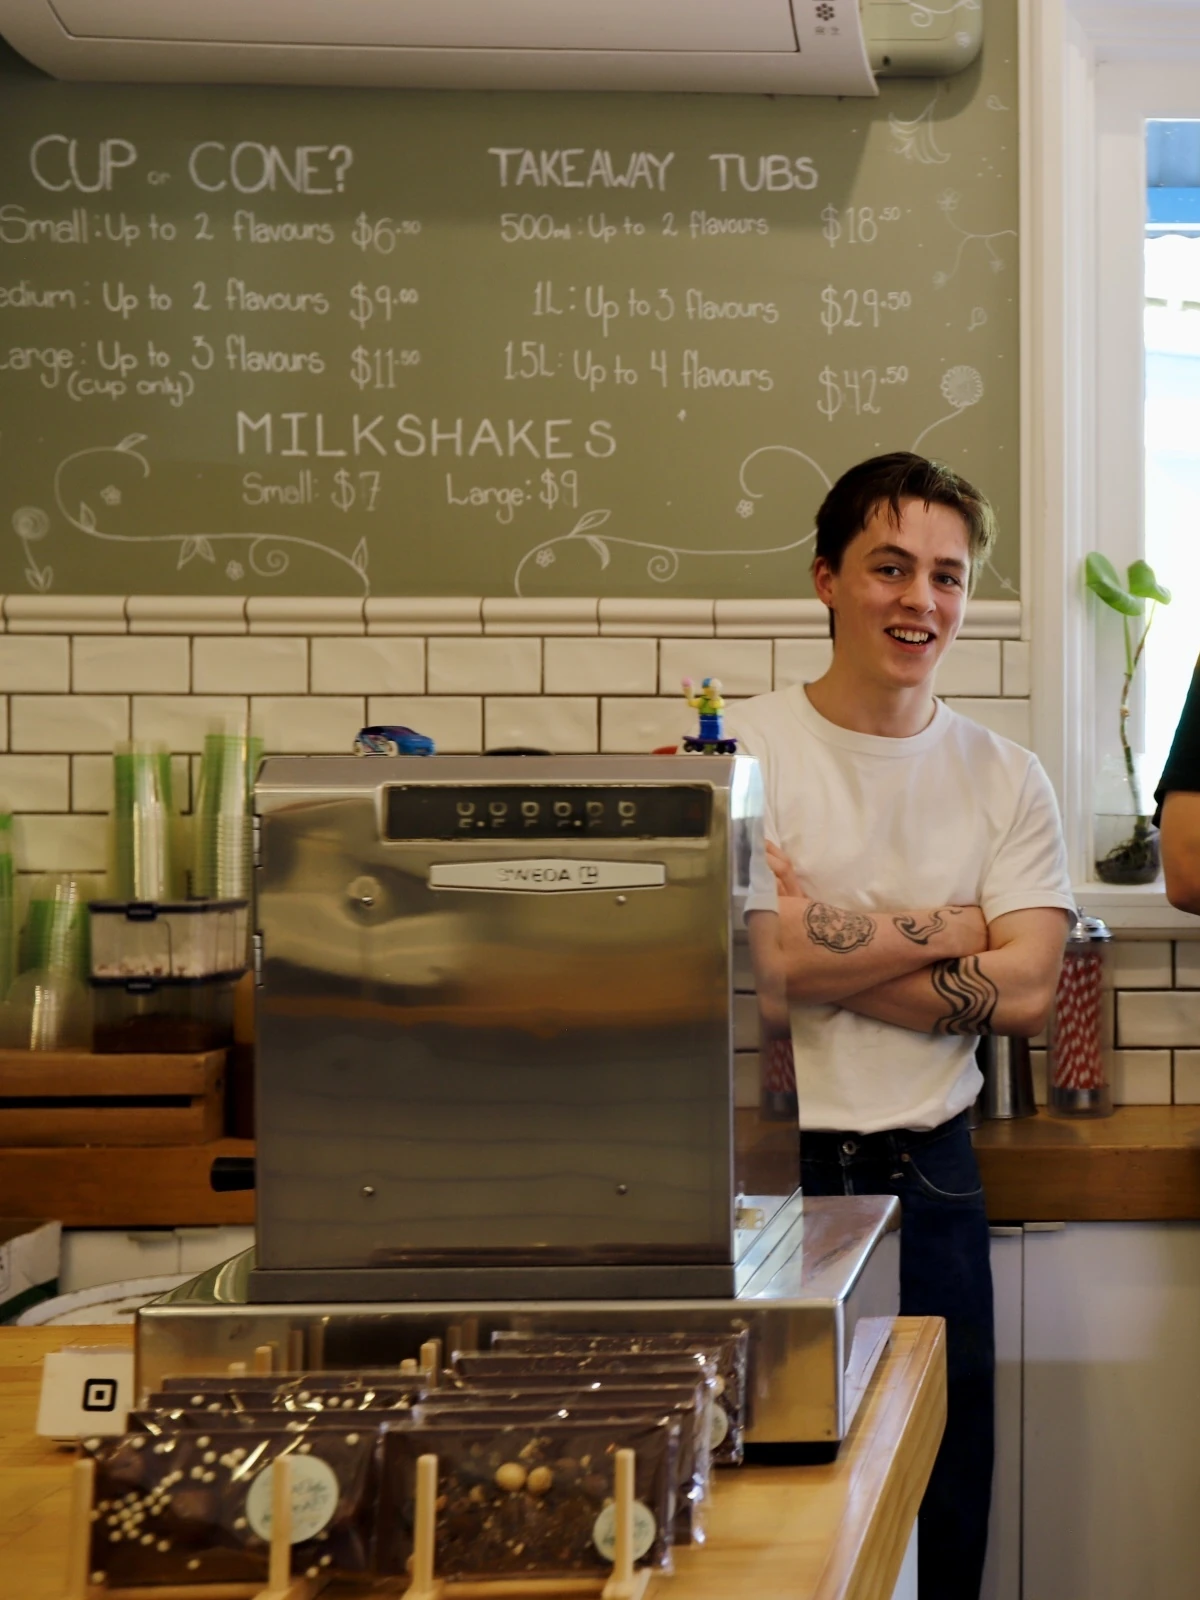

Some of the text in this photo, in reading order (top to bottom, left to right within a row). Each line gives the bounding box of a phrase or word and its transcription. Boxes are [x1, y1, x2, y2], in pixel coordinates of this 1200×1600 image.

[30, 135, 354, 194] CUP or CONE?
[487, 147, 819, 192] TAKEAWAY TUBS
[0, 204, 421, 254] Small: Up to 2 flavours $6.50
[587, 212, 617, 244] Up
[622, 215, 646, 237] to
[662, 211, 679, 237] 2
[689, 210, 770, 239] flavours
[821, 203, 901, 248] $18.50
[0, 277, 419, 330] edium: Up to 2 flavours $9.00
[585, 284, 619, 338] Up
[628, 287, 650, 317] to
[655, 288, 675, 321] 3
[686, 288, 779, 324] flavours
[821, 284, 912, 335] $29.50
[97, 340, 139, 378] Up
[148, 340, 171, 368] to
[192, 335, 215, 371] 3
[225, 333, 326, 374] flavours
[350, 344, 421, 391] $11.50
[573, 350, 606, 393] Up
[613, 354, 638, 385] to
[651, 350, 668, 388] 4
[681, 349, 774, 391] flavours
[817, 365, 909, 422] $42.50
[67, 370, 194, 407] (cup only)
[236, 410, 617, 460] MILKSHAKES
[242, 468, 382, 513] Small: $7
[446, 468, 579, 524] Large: $9
